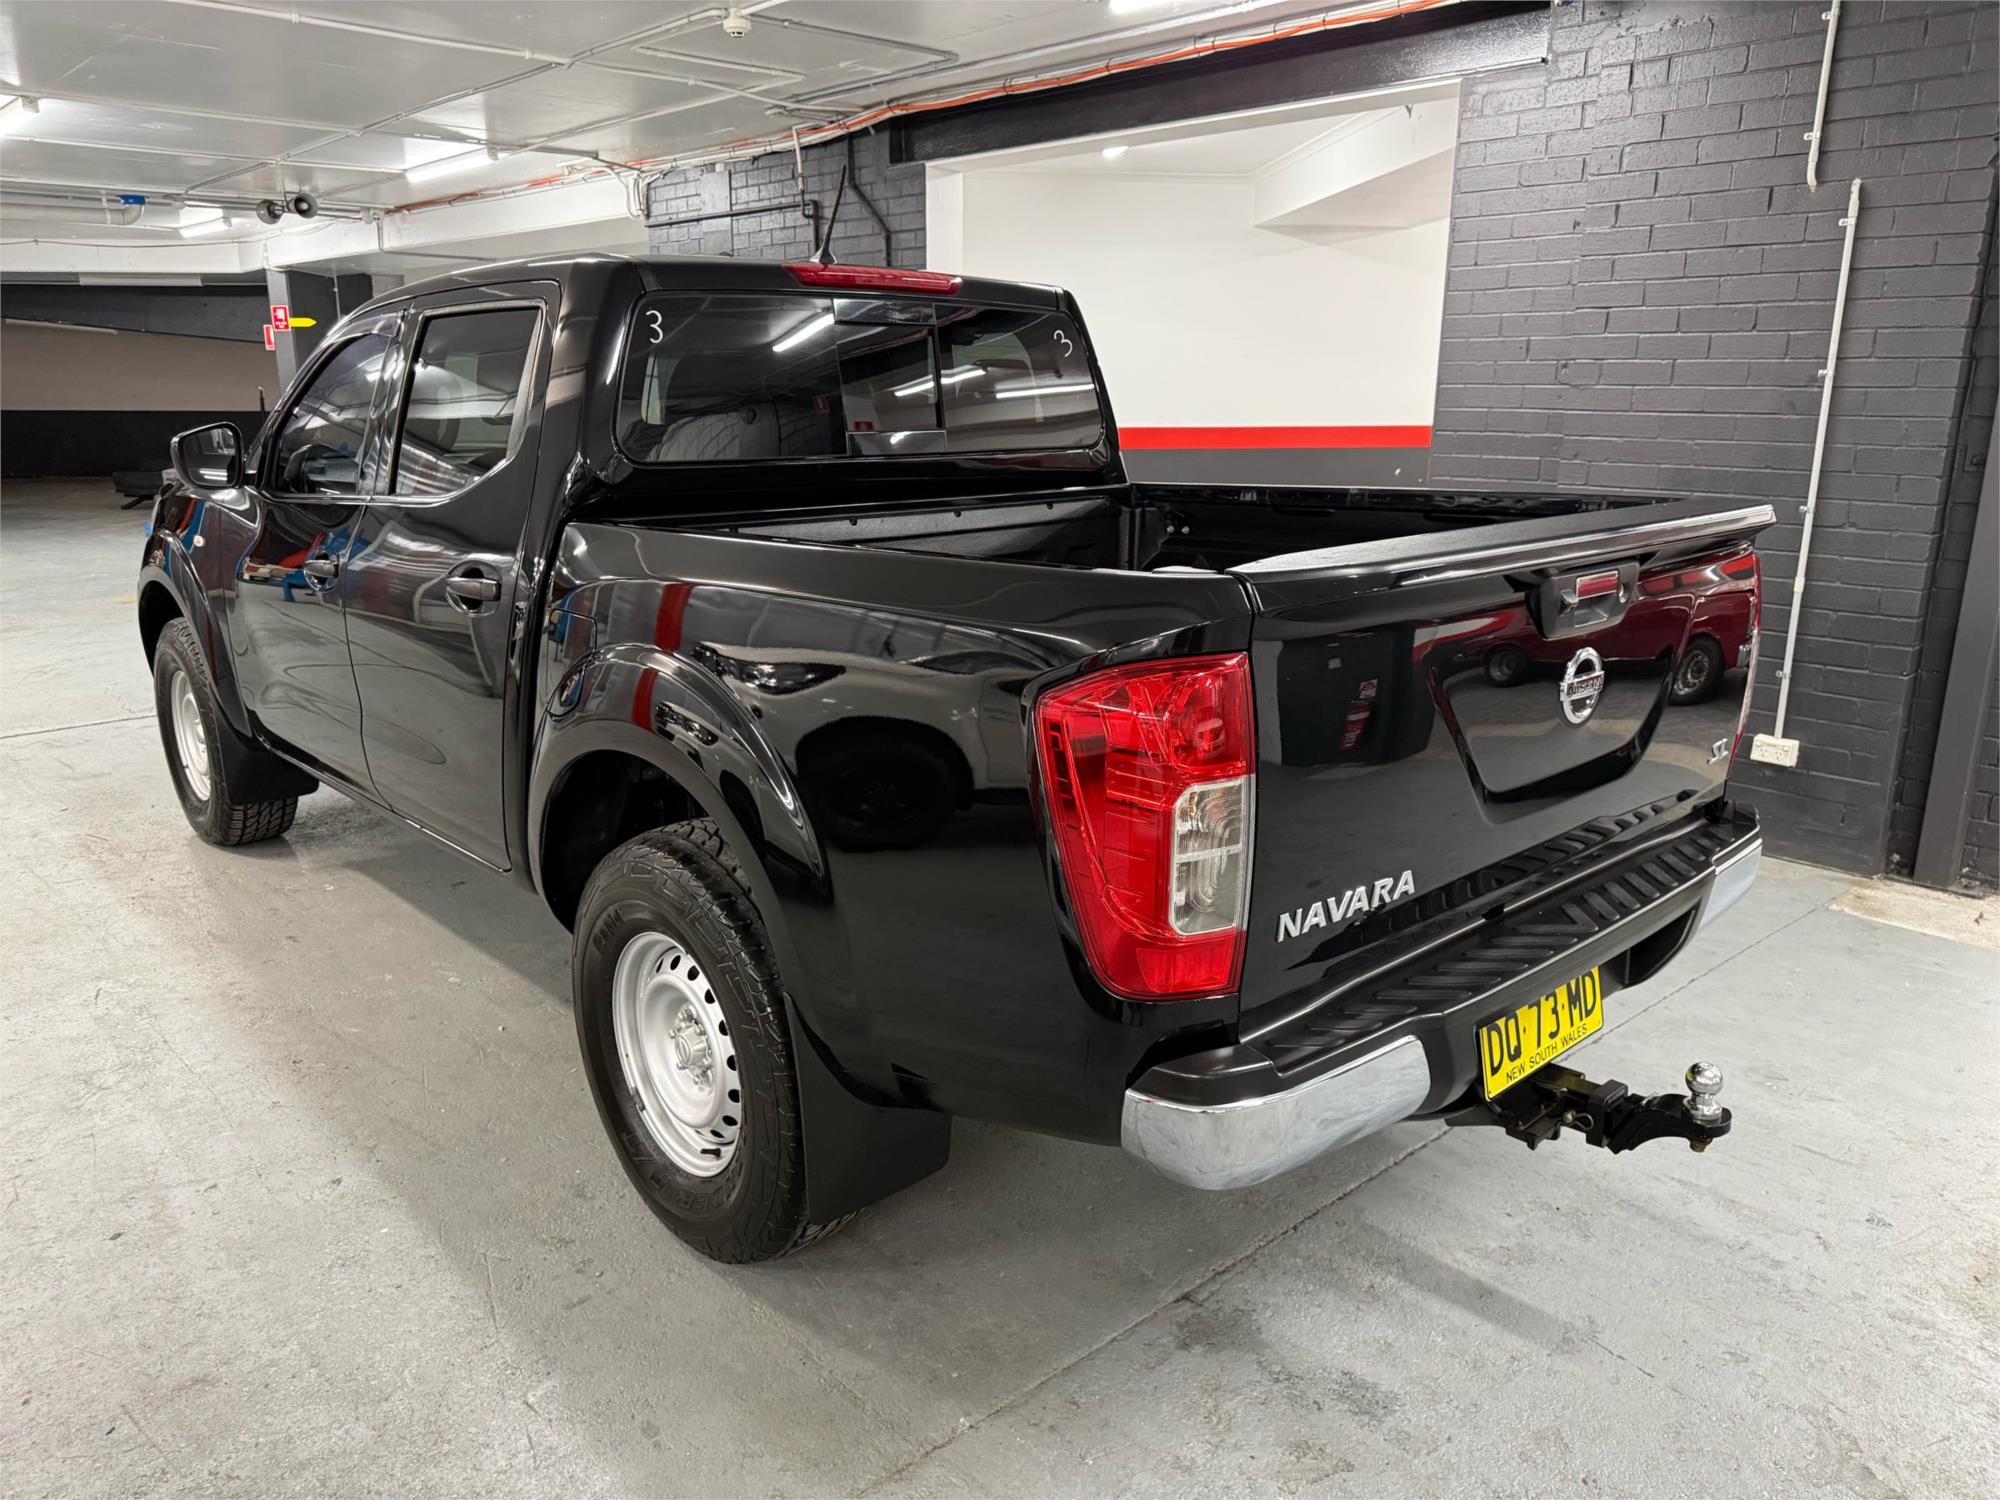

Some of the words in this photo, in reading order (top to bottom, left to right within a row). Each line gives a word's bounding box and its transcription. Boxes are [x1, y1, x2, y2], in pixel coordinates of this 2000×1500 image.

[645, 310, 664, 344] 3
[1053, 329, 1073, 358] 3
[1566, 677, 1602, 698] NISSAN
[1706, 737, 1729, 765] SL
[1276, 869, 1416, 943] NAVARA
[1505, 1060, 1526, 1083] NEW
[1528, 1043, 1559, 1069] SOUTH
[1560, 1022, 1589, 1047] WALES
